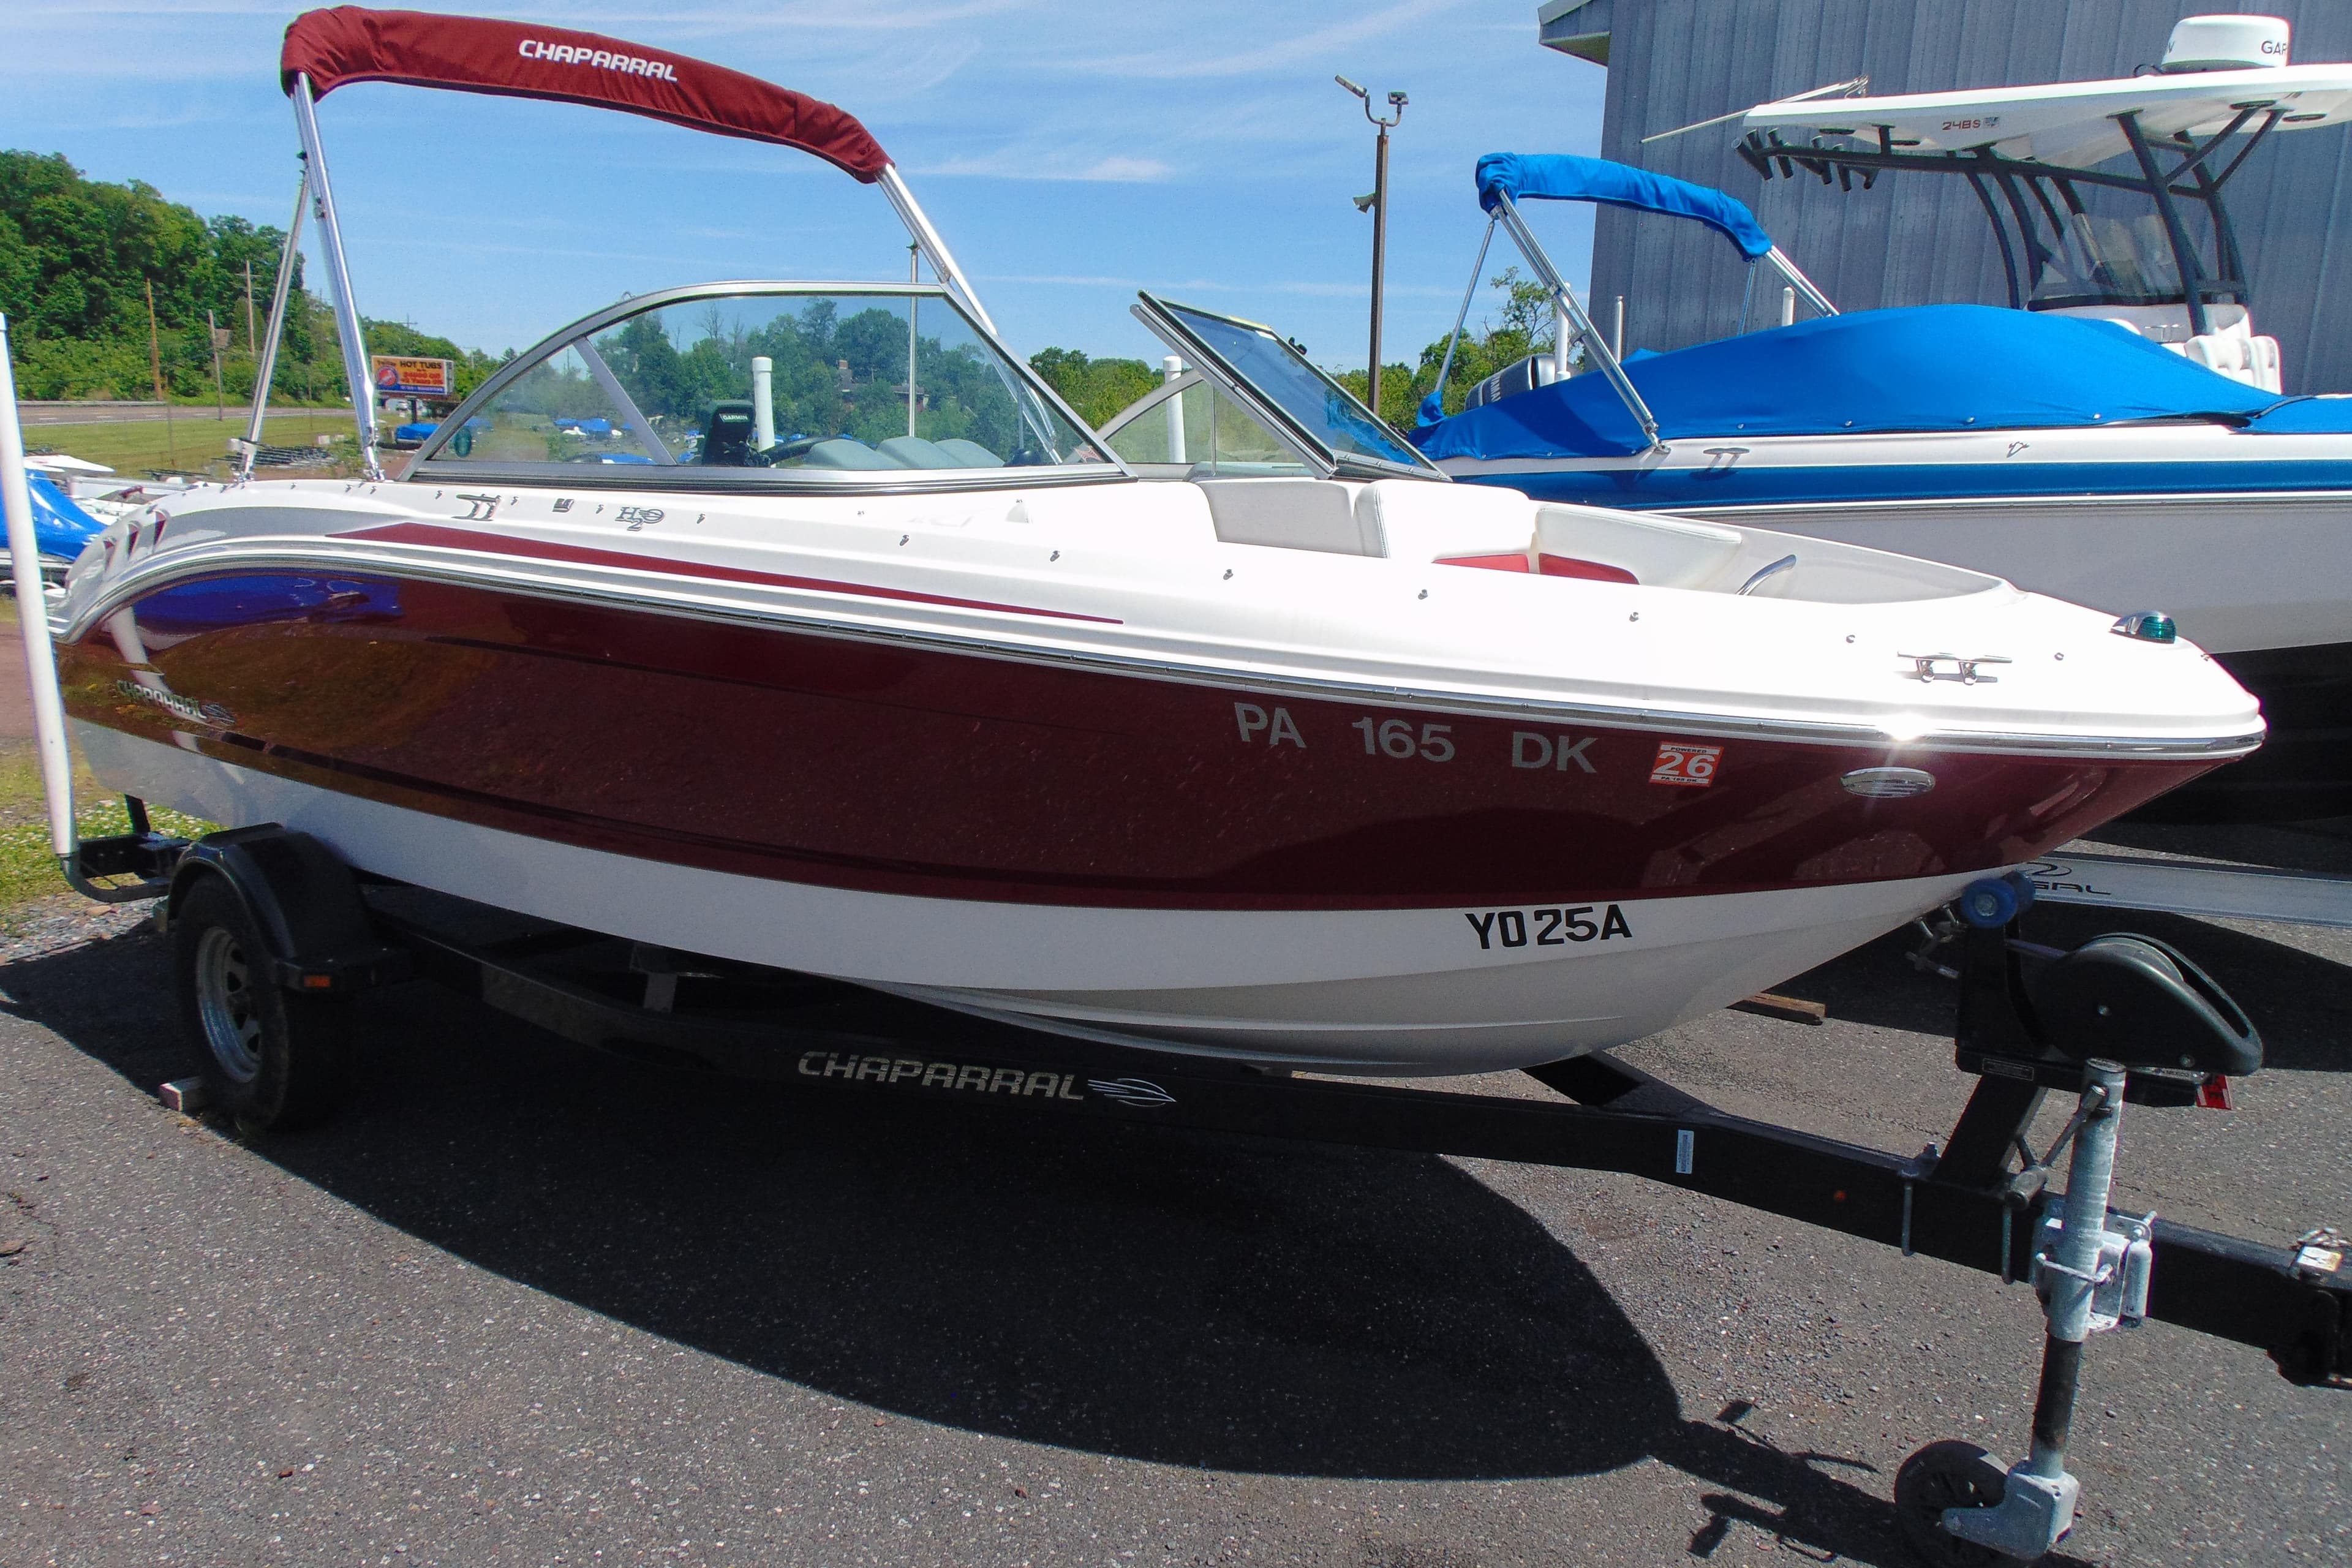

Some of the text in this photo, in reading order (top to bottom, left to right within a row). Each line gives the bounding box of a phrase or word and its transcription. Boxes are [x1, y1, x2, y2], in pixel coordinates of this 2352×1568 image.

[519, 39, 678, 83] CHAPARRAL
[1234, 702, 1600, 774] PA 165 DK
[1653, 752, 1716, 777] 26
[797, 1050, 1084, 1101] CHAPARRAL
